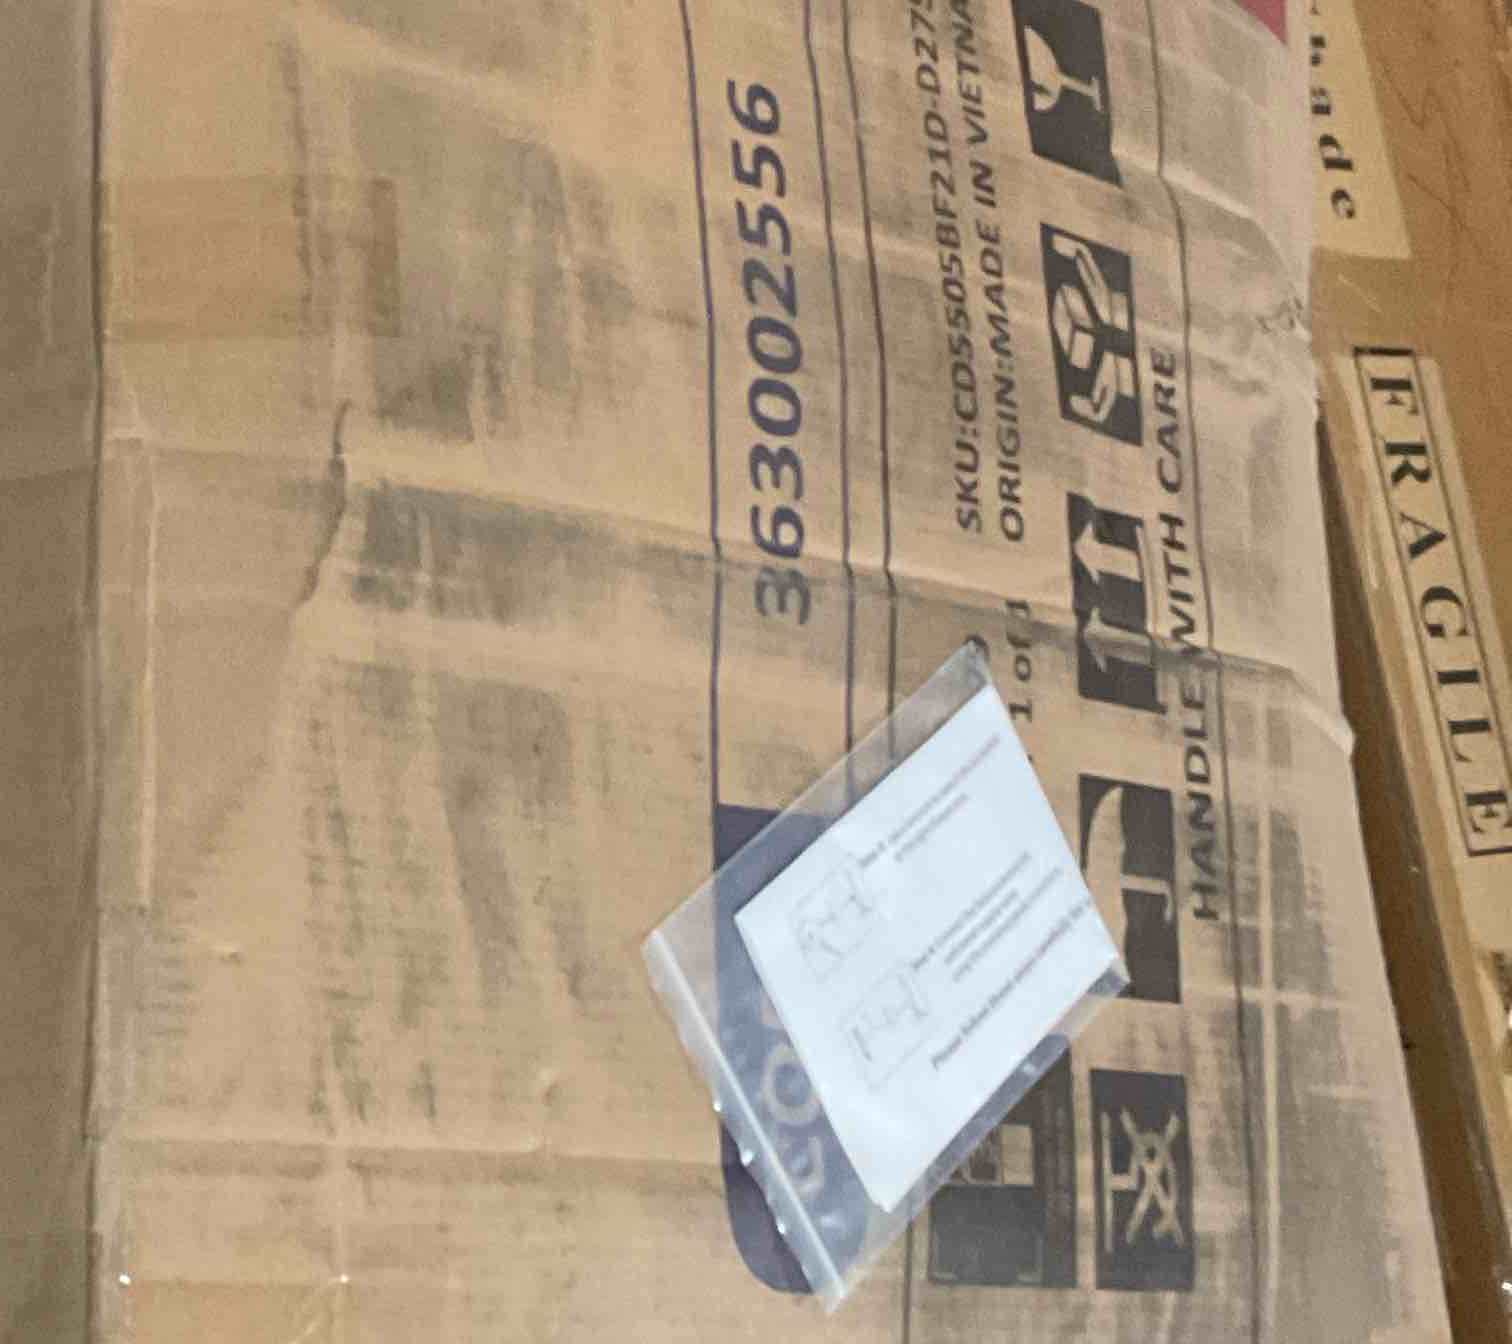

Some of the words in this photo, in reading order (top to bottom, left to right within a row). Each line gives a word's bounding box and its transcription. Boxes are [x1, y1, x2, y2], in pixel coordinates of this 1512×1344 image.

[970, 159, 998, 208] IN
[727, 77, 812, 627] 363002556
[976, 219, 1025, 542] ORIGIN:MADE
[1152, 347, 1184, 494] CARE
[1158, 512, 1202, 658] WITH
[1368, 374, 1512, 836] FRAGILE
[1182, 674, 1220, 920] HANDLE
